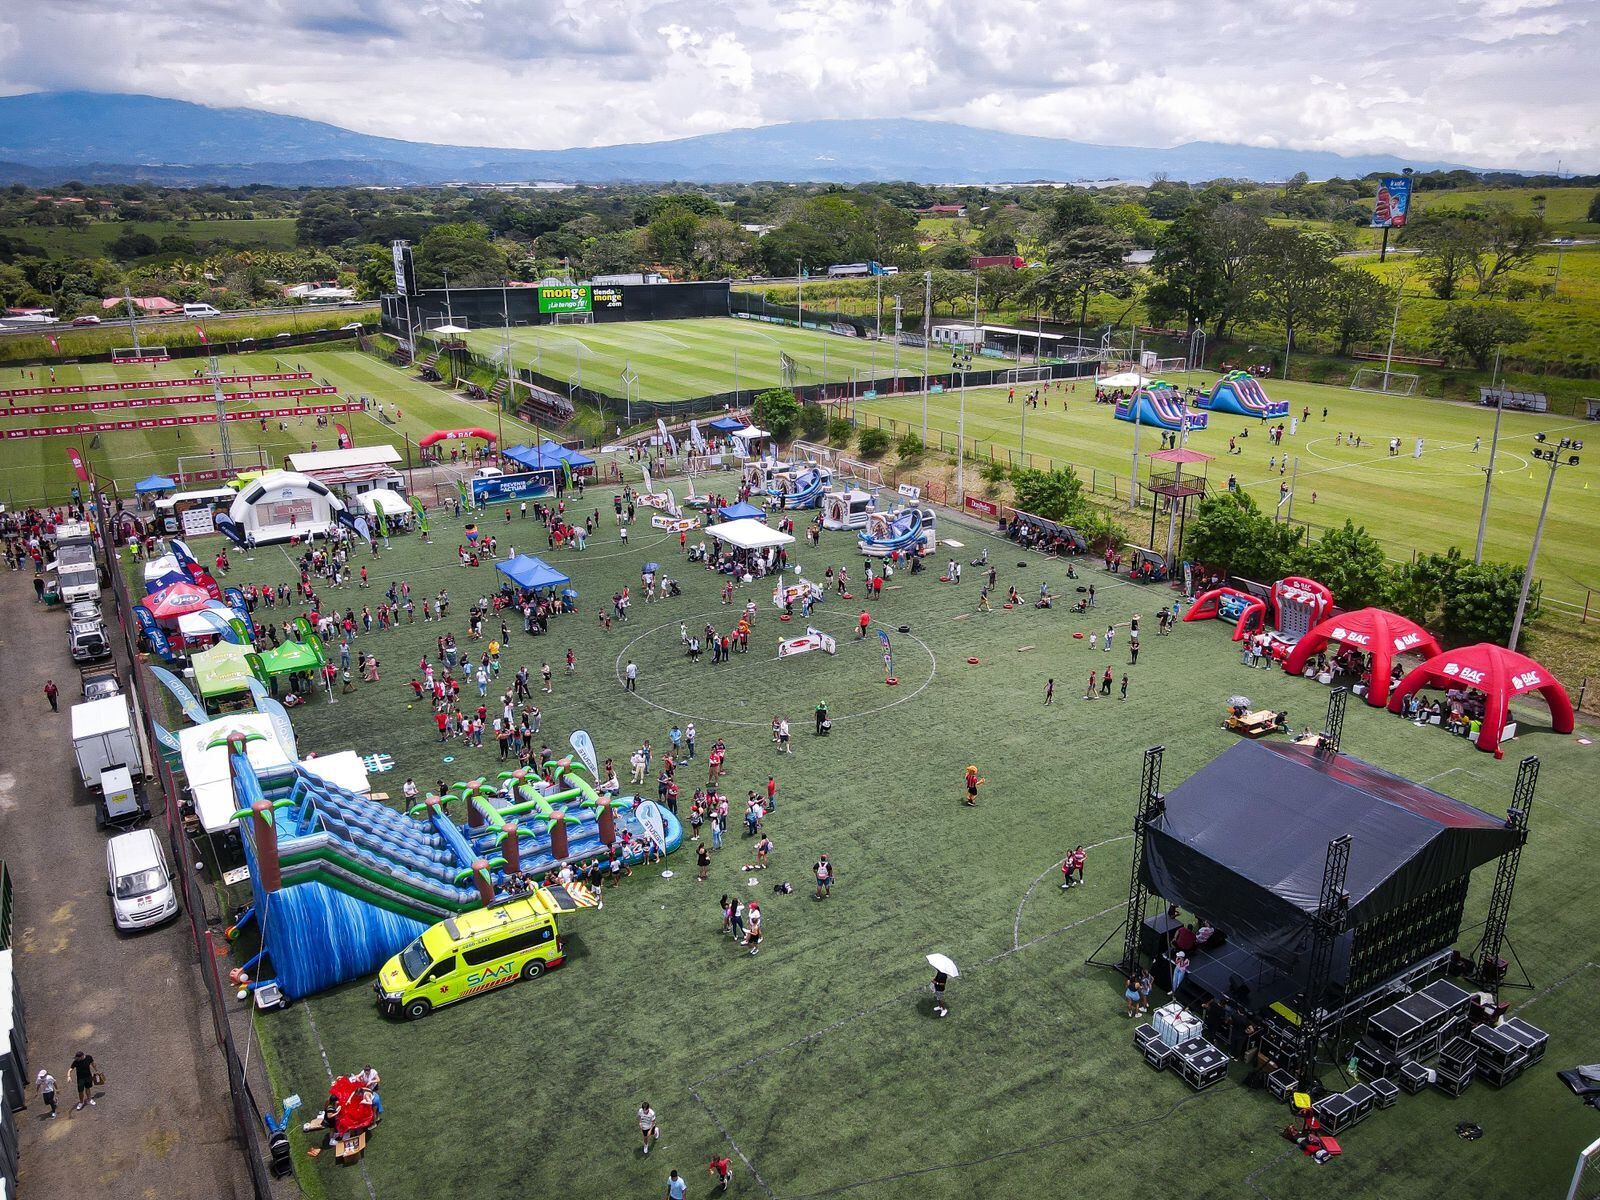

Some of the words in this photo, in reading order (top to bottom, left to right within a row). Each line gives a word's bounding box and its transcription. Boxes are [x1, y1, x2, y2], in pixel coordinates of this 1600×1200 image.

[542, 288, 586, 300] monge
[594, 294, 622, 302] monge
[1347, 632, 1370, 645] BAC
[1402, 633, 1420, 645] BAC
[1460, 667, 1485, 682] BAC
[1521, 671, 1540, 682] BAC
[467, 961, 515, 987] SAAT
